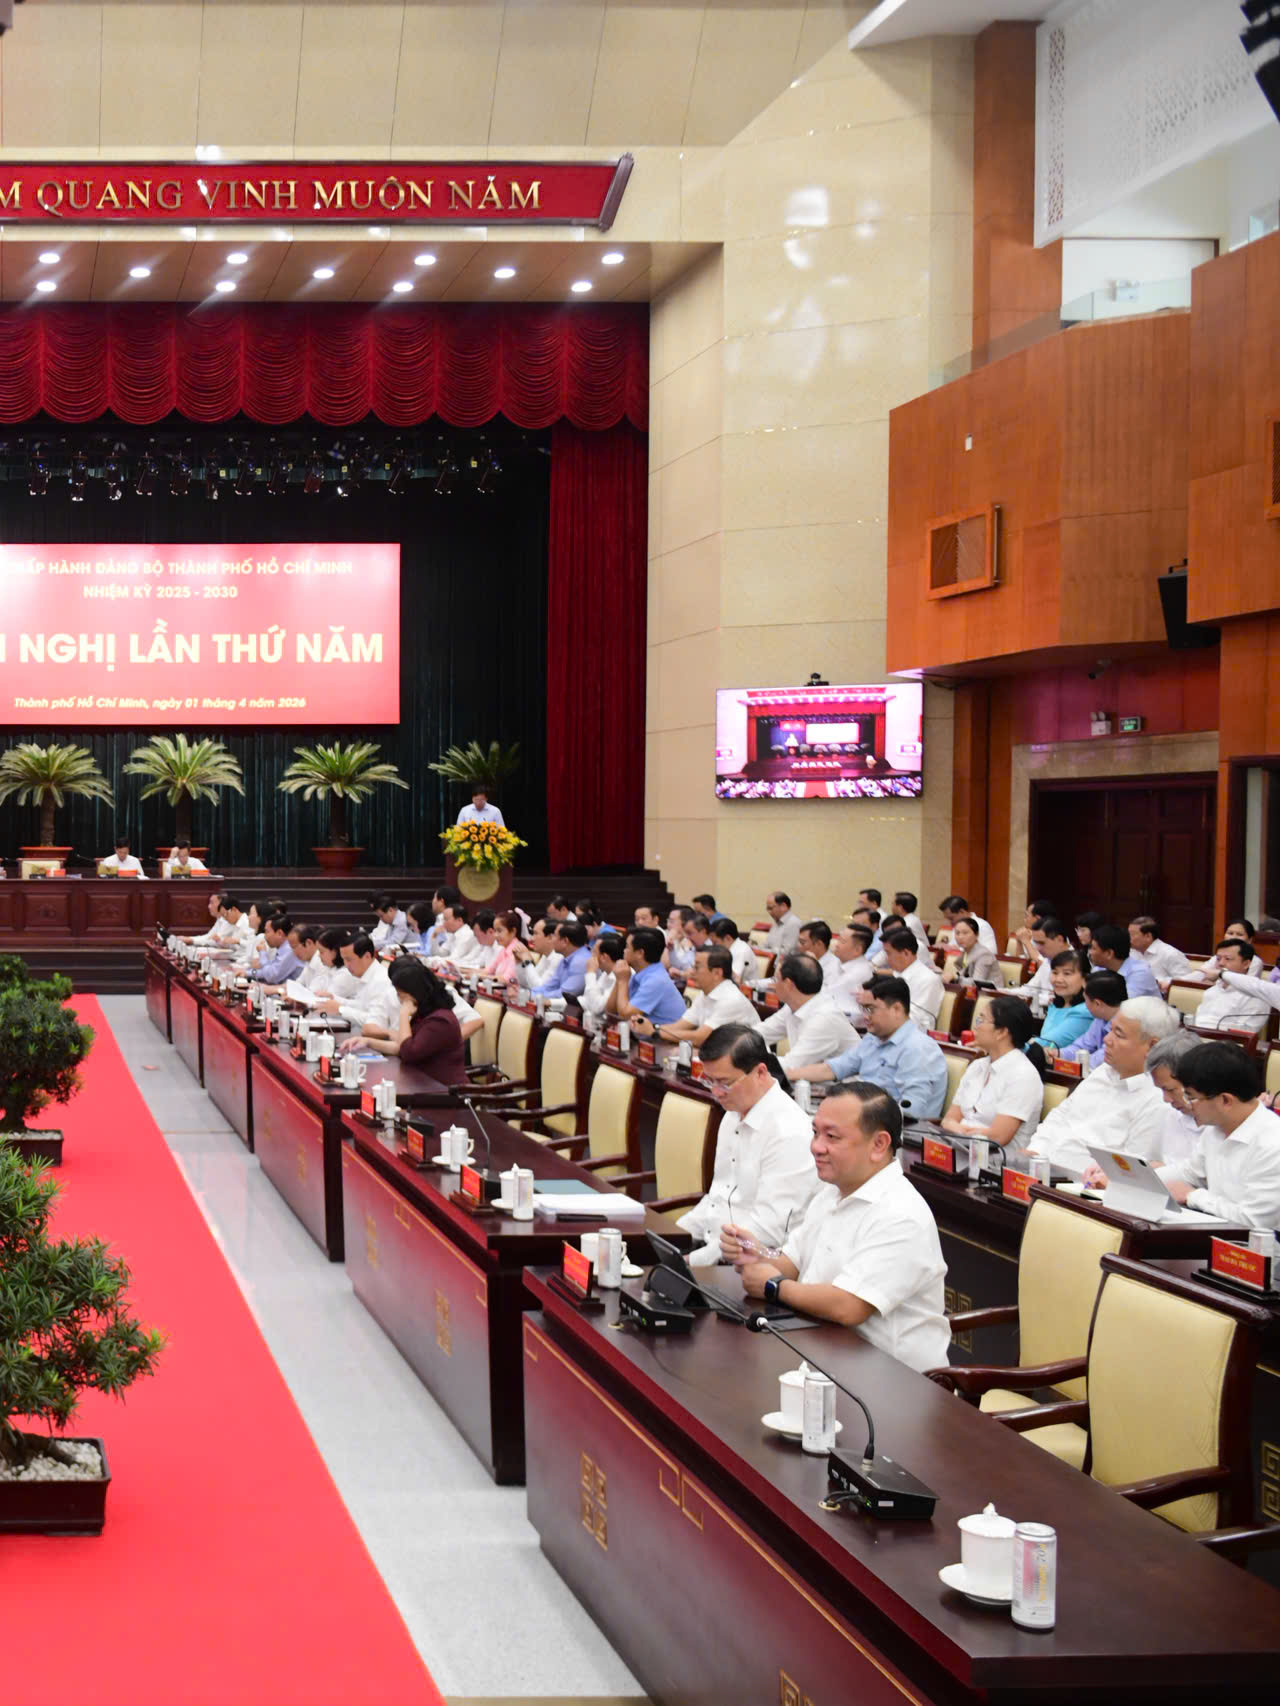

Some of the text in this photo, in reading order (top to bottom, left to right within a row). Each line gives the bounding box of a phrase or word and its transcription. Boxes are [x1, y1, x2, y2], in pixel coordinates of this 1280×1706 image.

[37, 180, 184, 216] QUANG
[196, 180, 299, 210] VINH
[313, 176, 435, 210] MUÔN
[447, 175, 543, 210] NĂM
[48, 559, 91, 574] HÀNH
[143, 559, 163, 576] BỘ
[221, 557, 253, 574] PHỐ
[314, 562, 353, 574] MINH
[83, 583, 129, 600] NHIỆM
[157, 586, 191, 598] 2025
[203, 586, 238, 598] 2030
[19, 633, 116, 672] NGHỊ
[129, 618, 201, 664] LẦN
[211, 624, 287, 664] THỨ
[296, 625, 383, 664] NĂM
